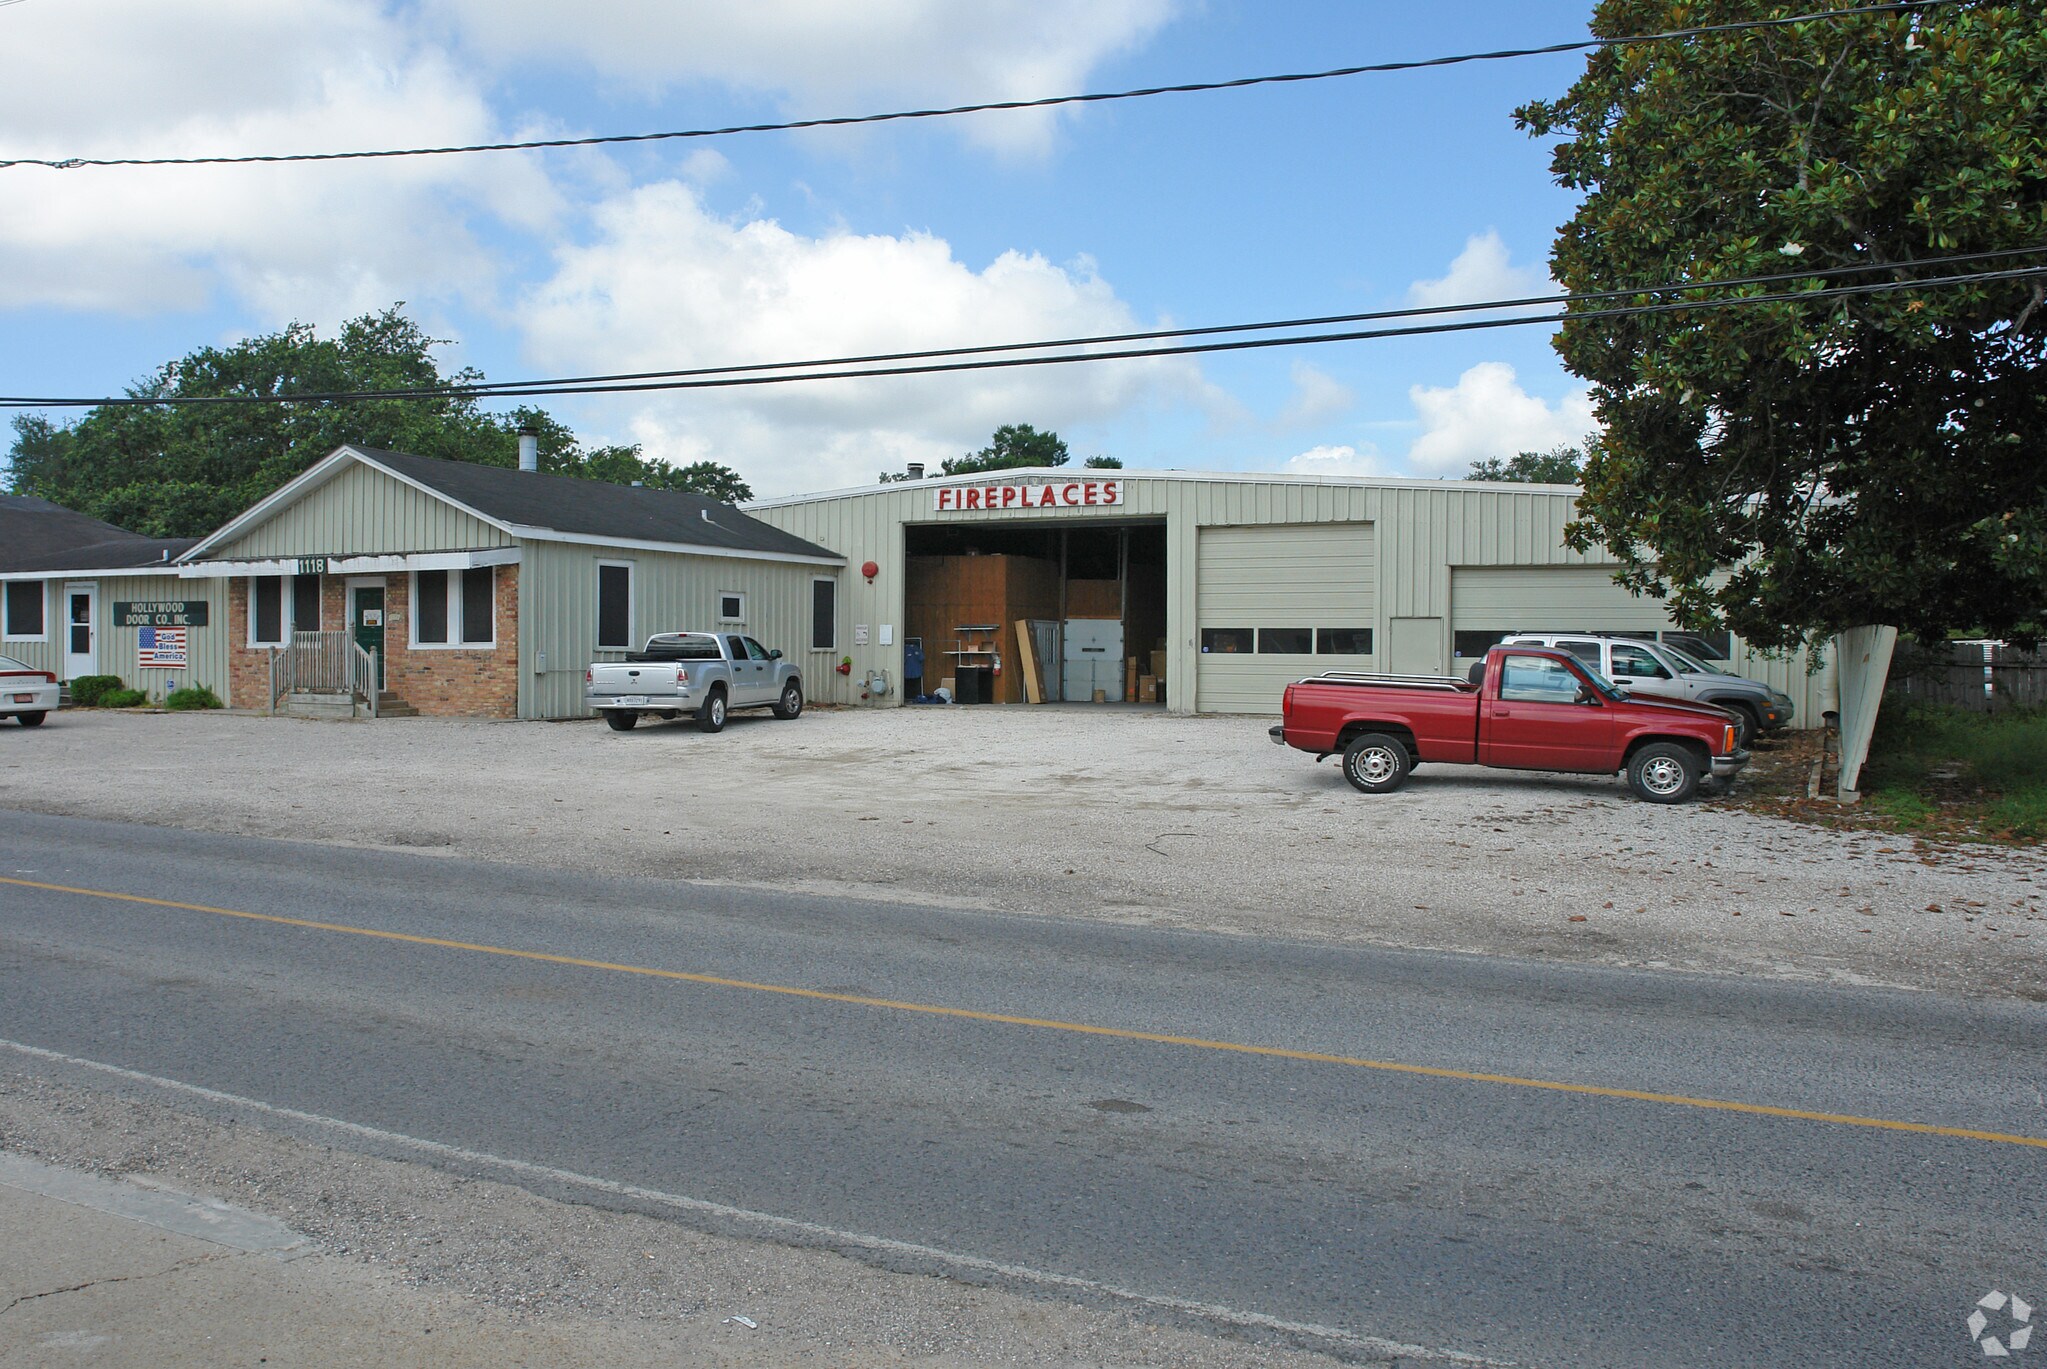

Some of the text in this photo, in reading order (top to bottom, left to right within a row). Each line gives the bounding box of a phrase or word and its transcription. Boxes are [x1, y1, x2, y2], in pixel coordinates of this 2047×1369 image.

[939, 482, 1117, 510] FIREPLACES
[300, 559, 324, 573] 1118
[131, 602, 185, 613] HOLLYWOOD
[126, 614, 150, 625] DOOR
[174, 614, 191, 625] INC.
[158, 642, 178, 650] Bless
[154, 652, 183, 660] America
